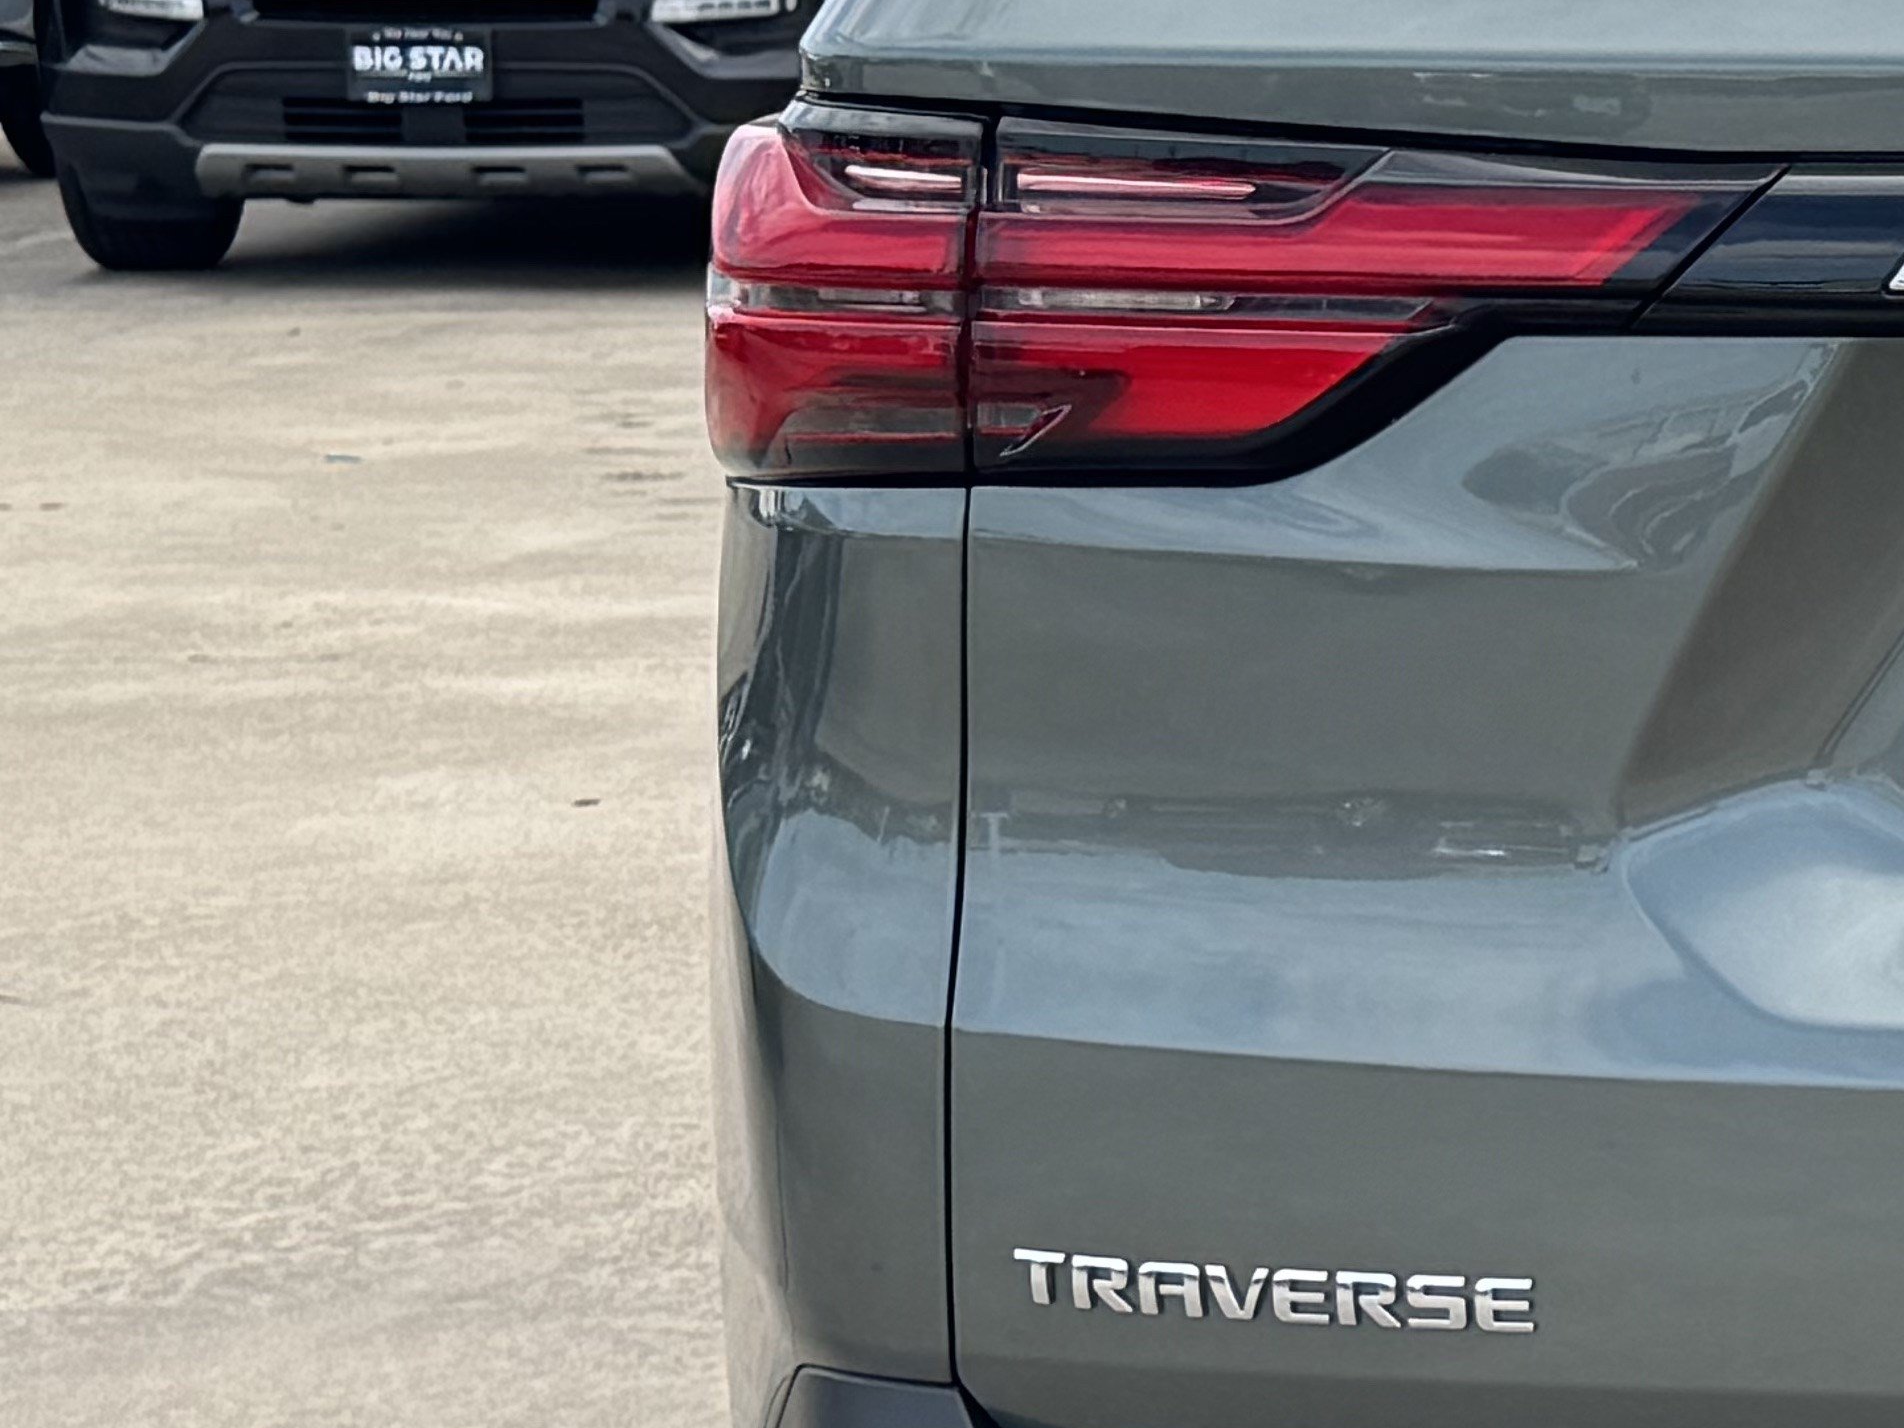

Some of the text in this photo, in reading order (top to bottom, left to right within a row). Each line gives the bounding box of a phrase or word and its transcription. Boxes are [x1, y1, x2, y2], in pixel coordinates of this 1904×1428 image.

[353, 45, 484, 73] BIG STAR
[1013, 1248, 1534, 1332] TRAVERSE
